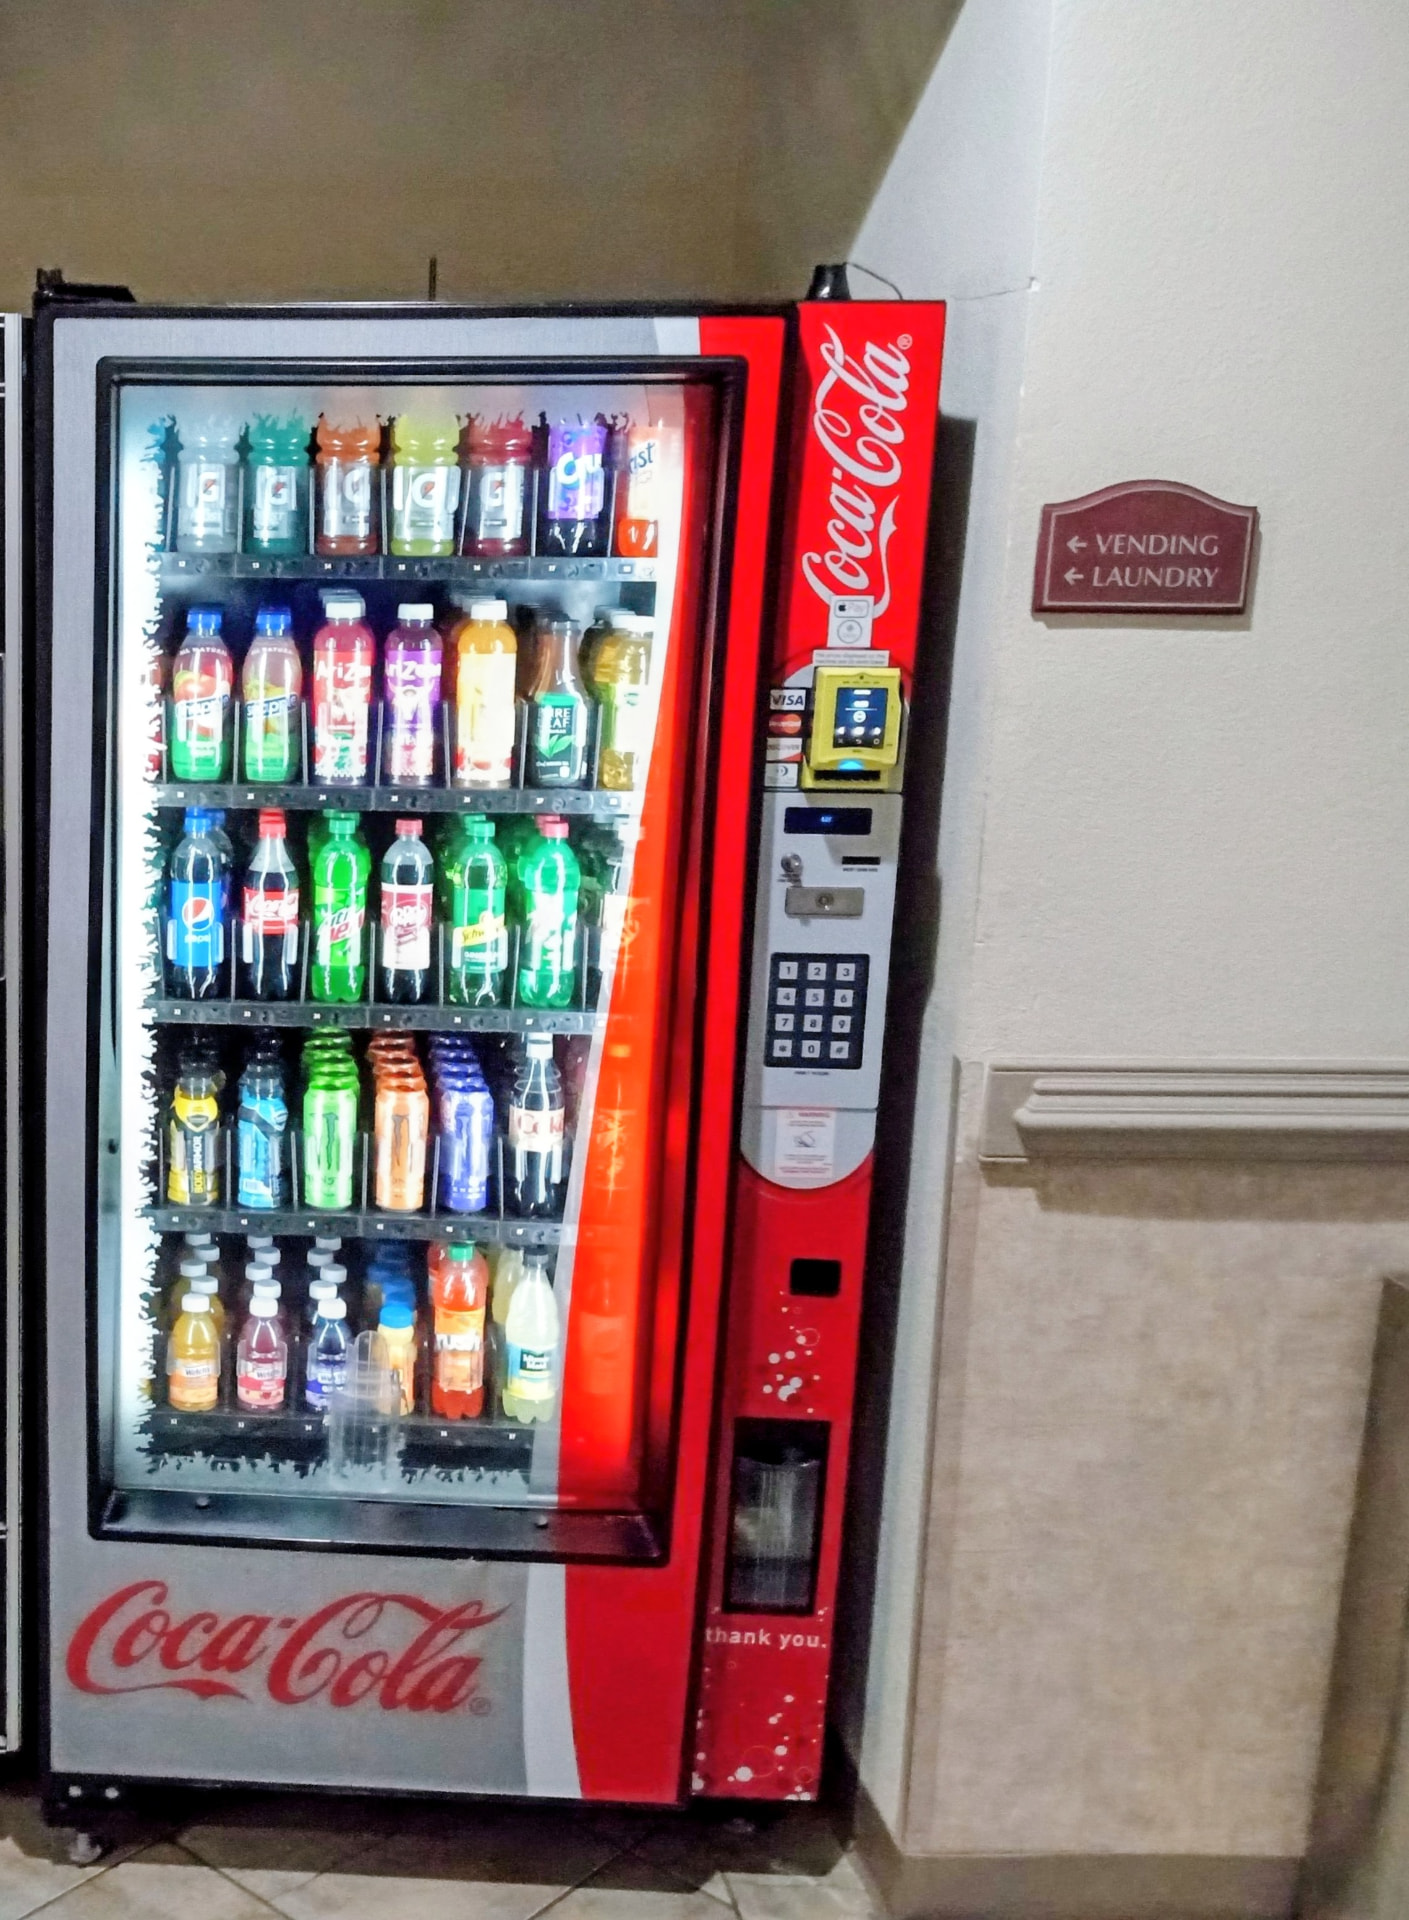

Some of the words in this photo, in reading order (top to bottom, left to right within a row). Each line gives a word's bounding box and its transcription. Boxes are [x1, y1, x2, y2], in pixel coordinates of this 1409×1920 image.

[1096, 534, 1219, 556] VENDING
[1092, 566, 1218, 588] LAUNDRY
[772, 695, 804, 706] VISA
[66, 1580, 513, 1713] Coca-Cola
[705, 1627, 771, 1645] thank
